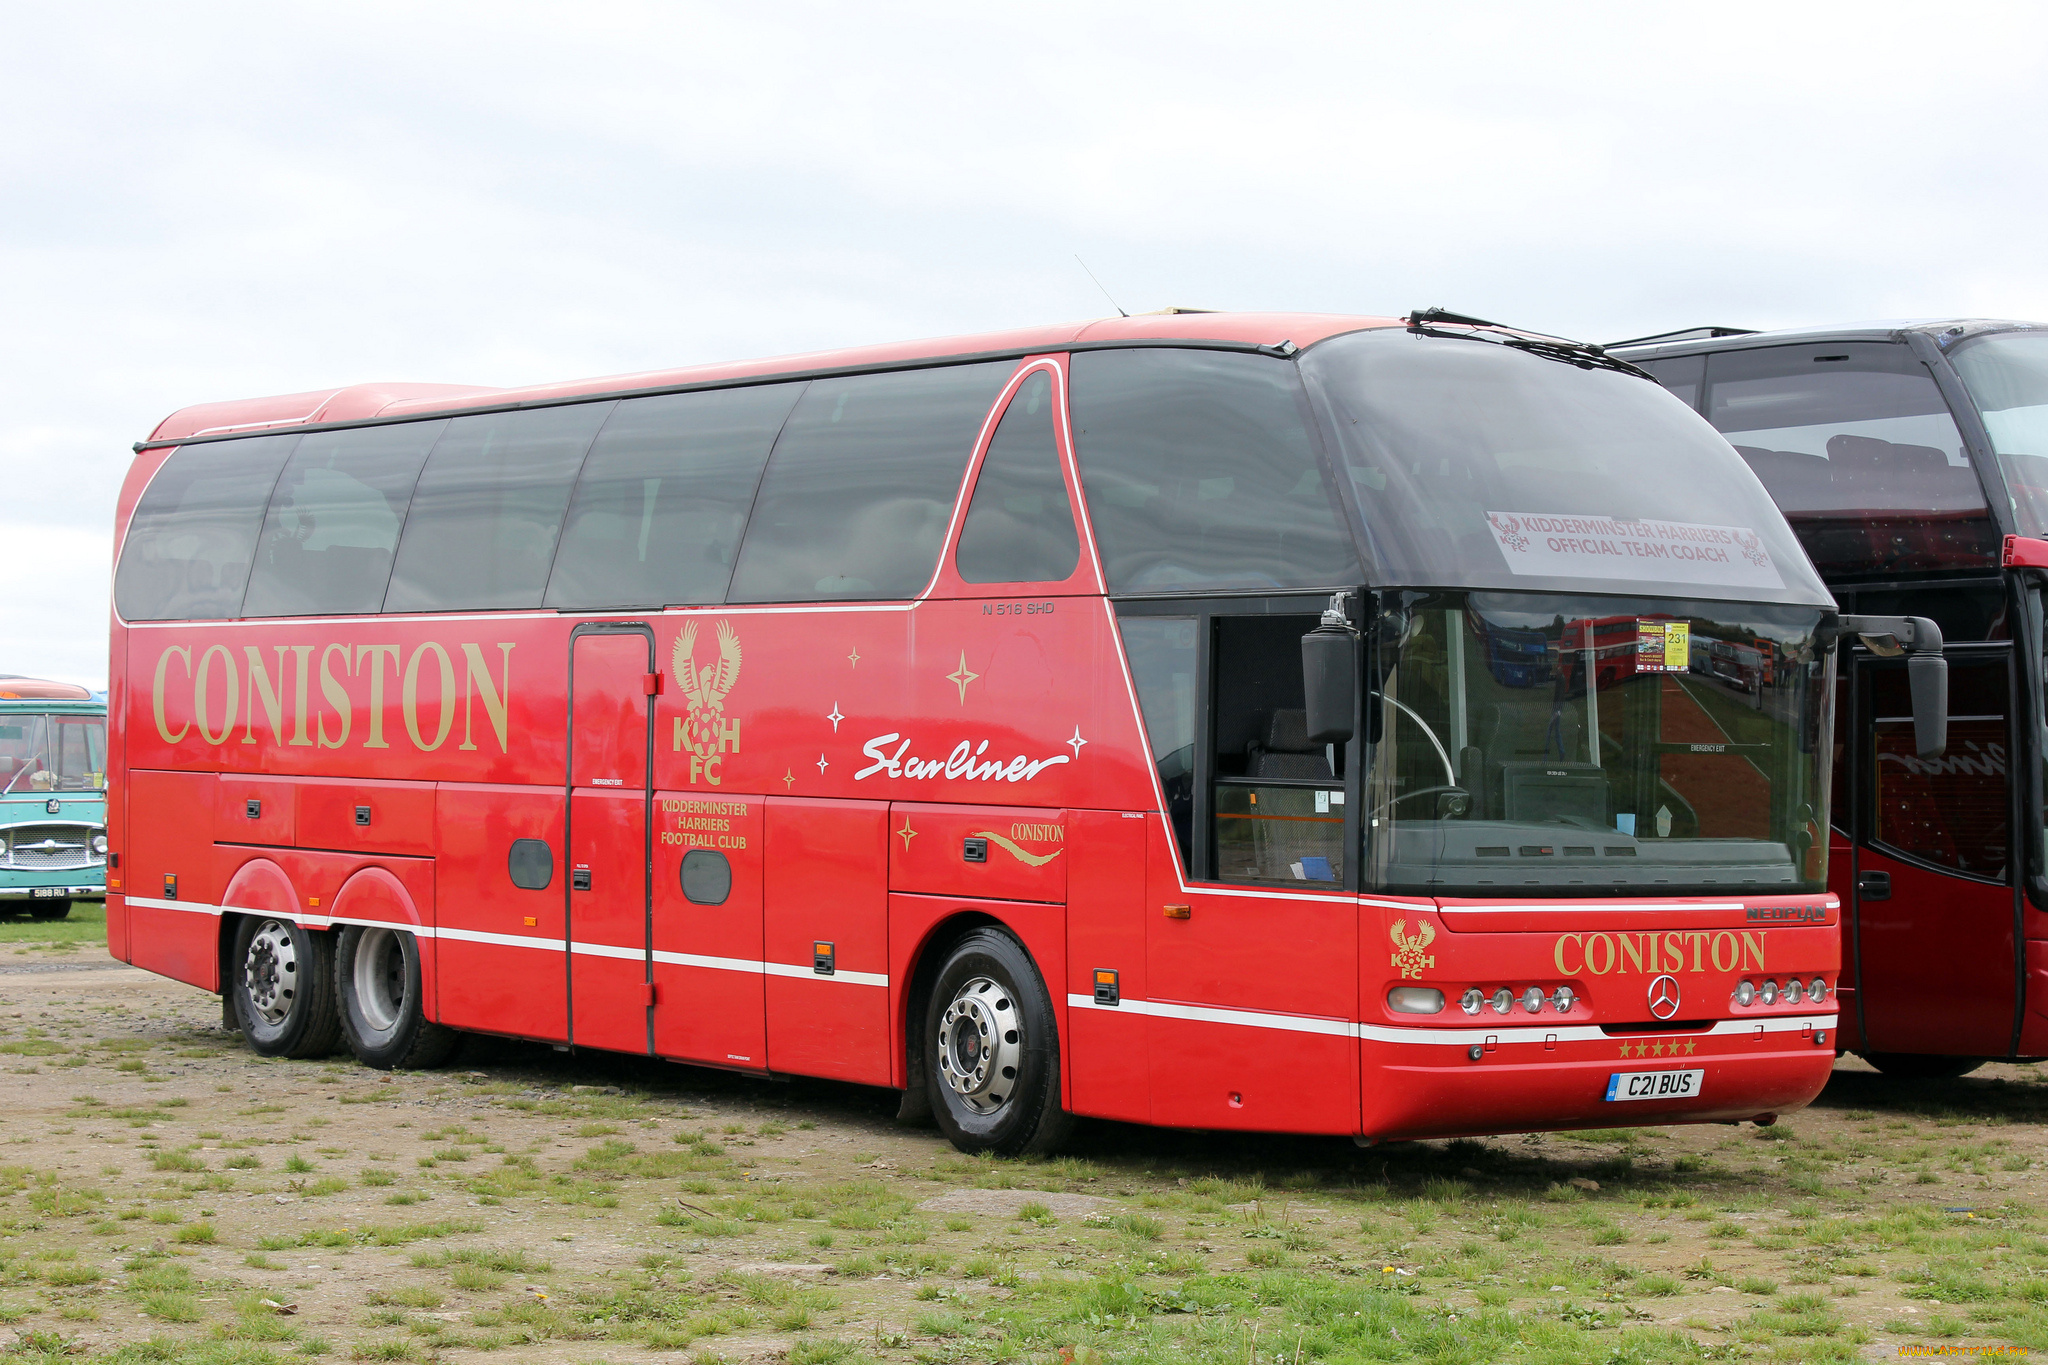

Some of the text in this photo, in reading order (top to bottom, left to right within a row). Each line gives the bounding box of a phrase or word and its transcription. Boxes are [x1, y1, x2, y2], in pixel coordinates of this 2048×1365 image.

[1521, 517, 1733, 545] KIDDERMINSTER HARRIERS
[1546, 537, 1730, 563] OFFICIAL TEAM COACH
[982, 602, 1054, 615] N 516 SHD
[1668, 633, 1686, 644] 231
[153, 642, 516, 754] CONISTON
[854, 732, 1070, 782] Starliner
[1691, 744, 1715, 752] EMERGENCY
[690, 756, 722, 786] FC
[662, 799, 748, 816] KIDDERMINSTER
[678, 816, 730, 832] HARRIERS
[1011, 822, 1065, 842] CONISTON
[661, 832, 747, 850] FOOTBALL CLUB
[34, 888, 65, 897] 5188 RU
[1746, 905, 1826, 923] NEOPLAN
[1554, 931, 1767, 976] CONISTON
[1401, 968, 1423, 980] FC
[1628, 1073, 1692, 1097] C21 BUS
